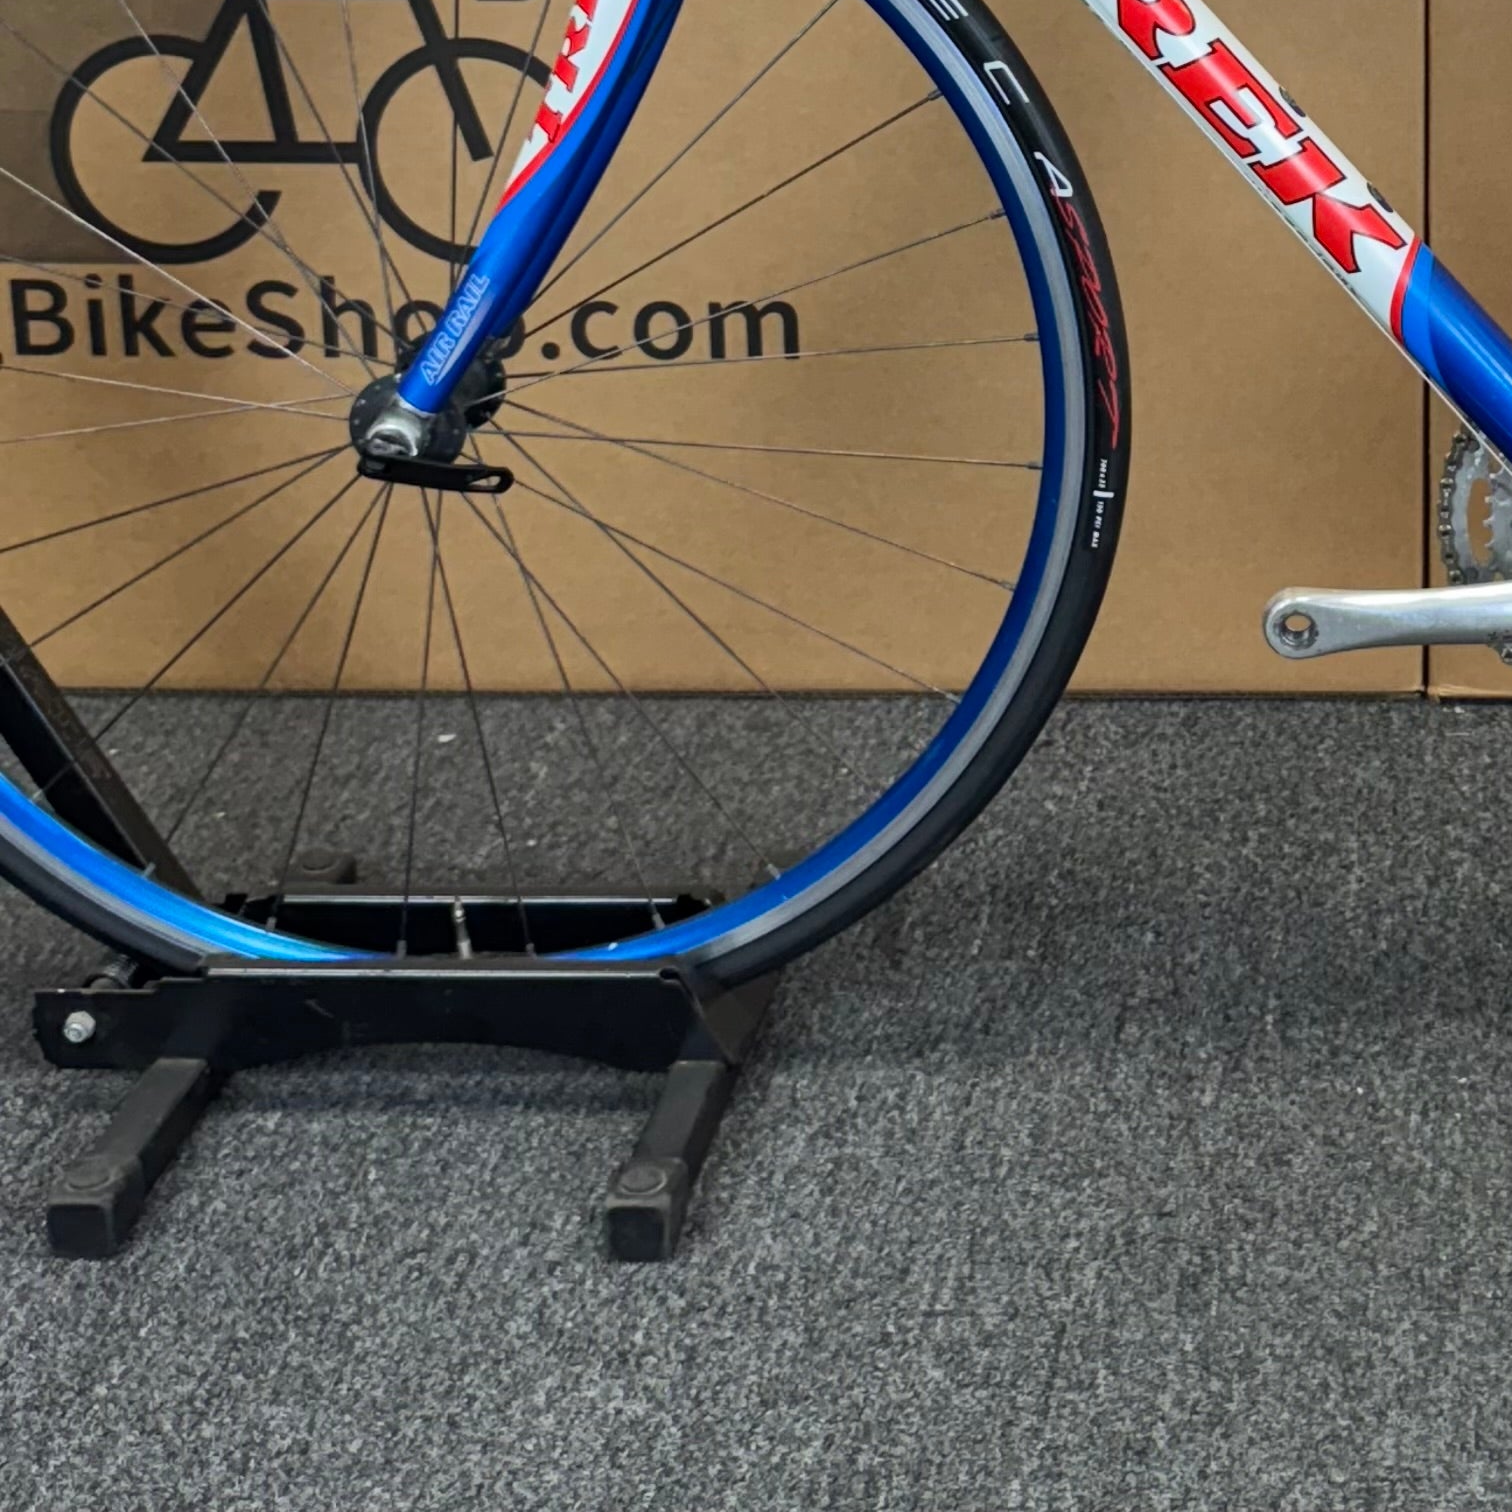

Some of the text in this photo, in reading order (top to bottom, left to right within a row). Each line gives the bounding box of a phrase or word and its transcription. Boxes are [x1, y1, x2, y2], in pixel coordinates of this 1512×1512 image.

[9, 274, 800, 361] BikeSho.com
[420, 272, 491, 386] AIR RAIL
